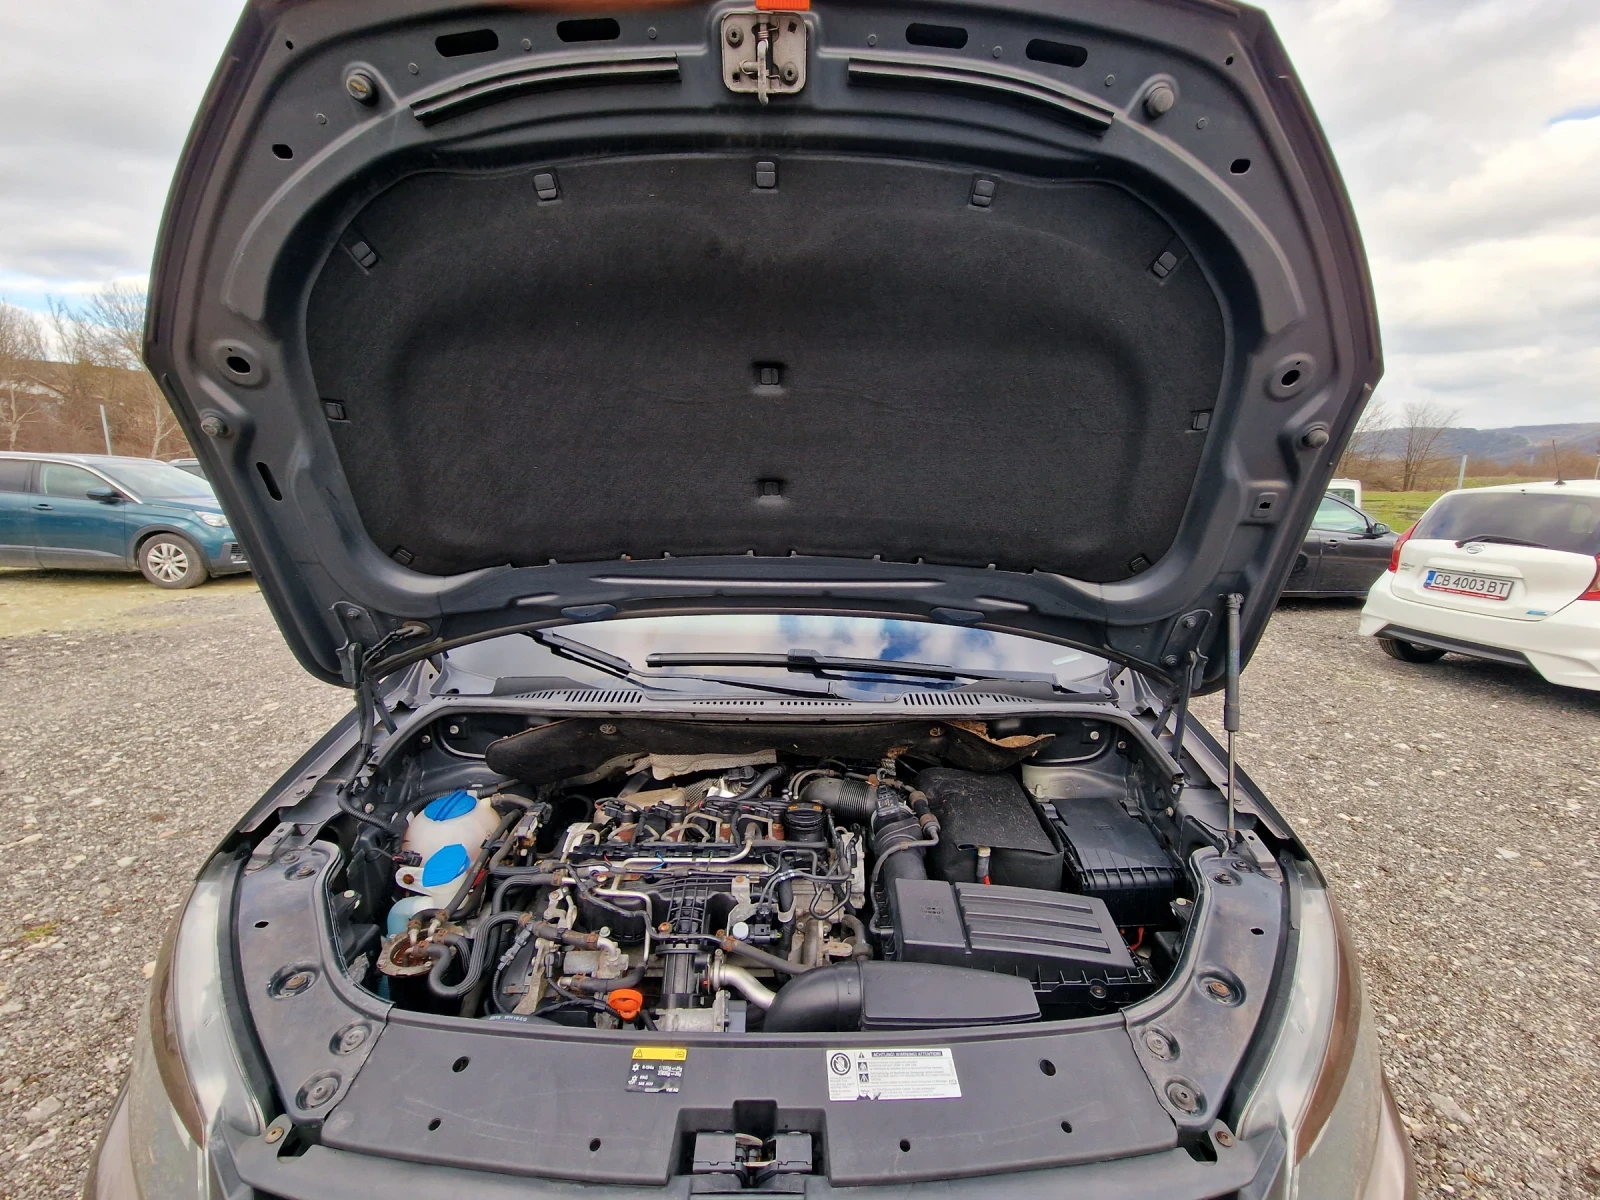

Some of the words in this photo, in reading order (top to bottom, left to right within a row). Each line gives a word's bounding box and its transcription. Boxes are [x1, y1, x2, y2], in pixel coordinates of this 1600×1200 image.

[1434, 574, 1452, 587] CB
[1453, 577, 1486, 591] 4003
[1487, 581, 1509, 595] BT
